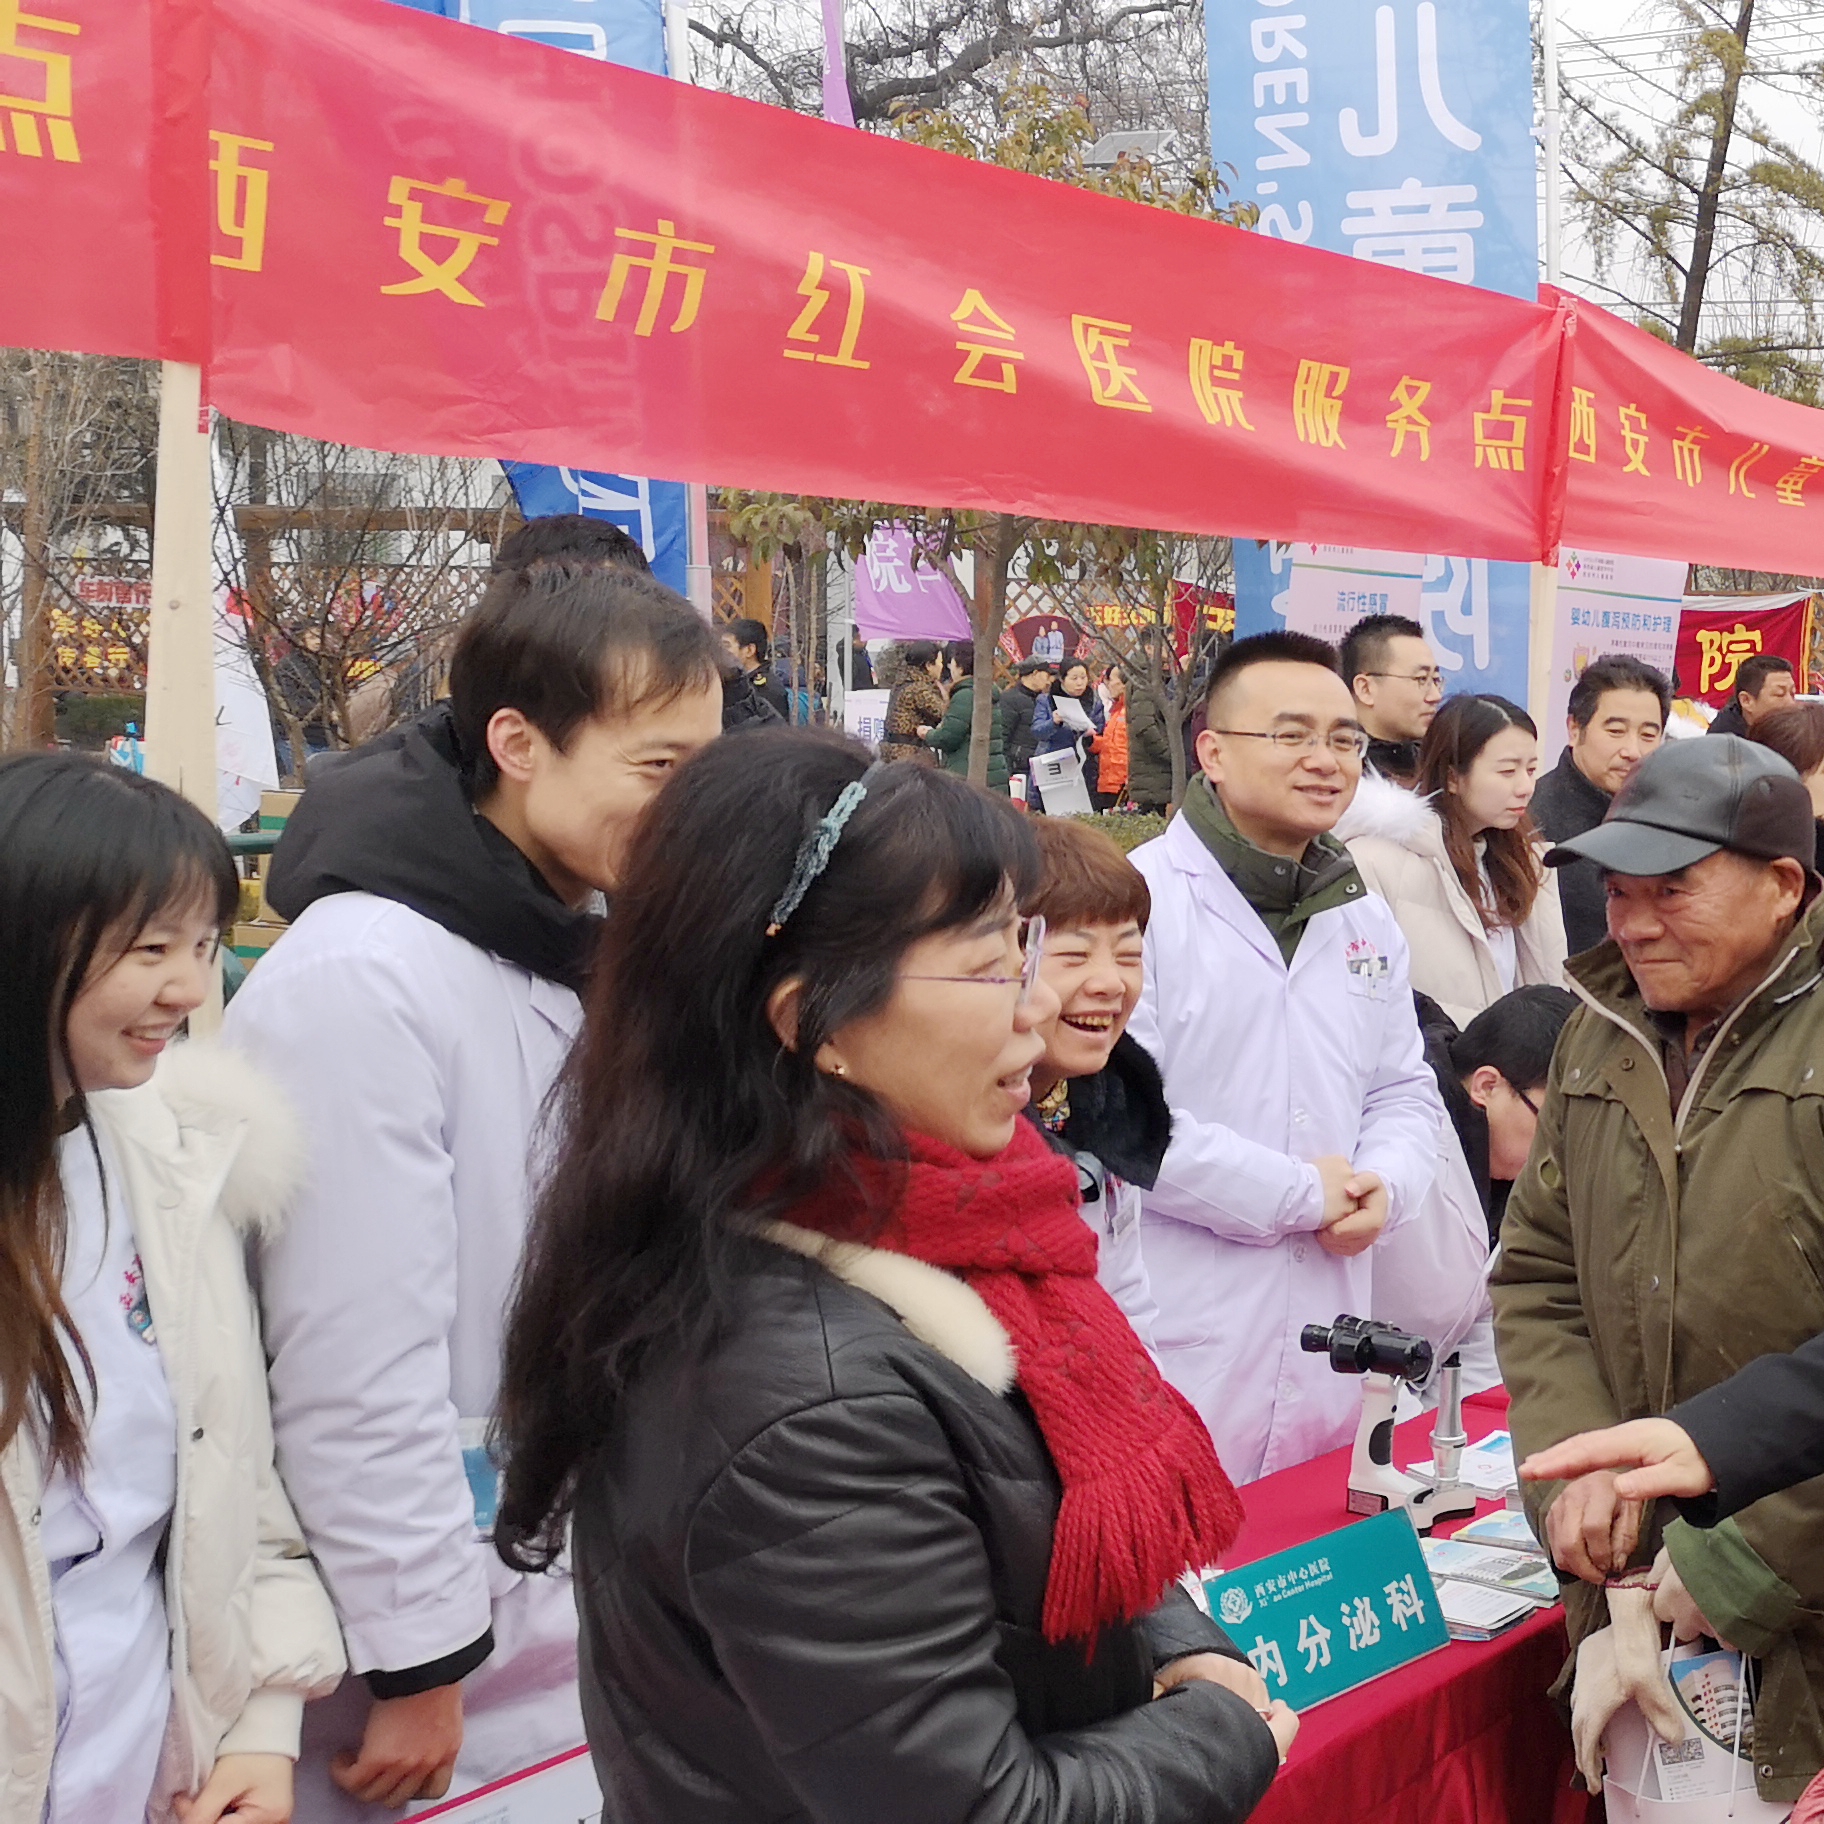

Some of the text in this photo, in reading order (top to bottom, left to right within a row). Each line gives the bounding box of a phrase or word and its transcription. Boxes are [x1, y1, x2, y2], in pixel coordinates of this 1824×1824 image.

[209, 129, 1534, 472] 西安市红会医院服务点
[1571, 607, 1673, 633] 婴幼儿腹泻预防和护理
[1696, 624, 1763, 694] 院
[1253, 1557, 1332, 1599] 西安市中心医院
[1247, 1573, 1425, 1687] 内分泌科
